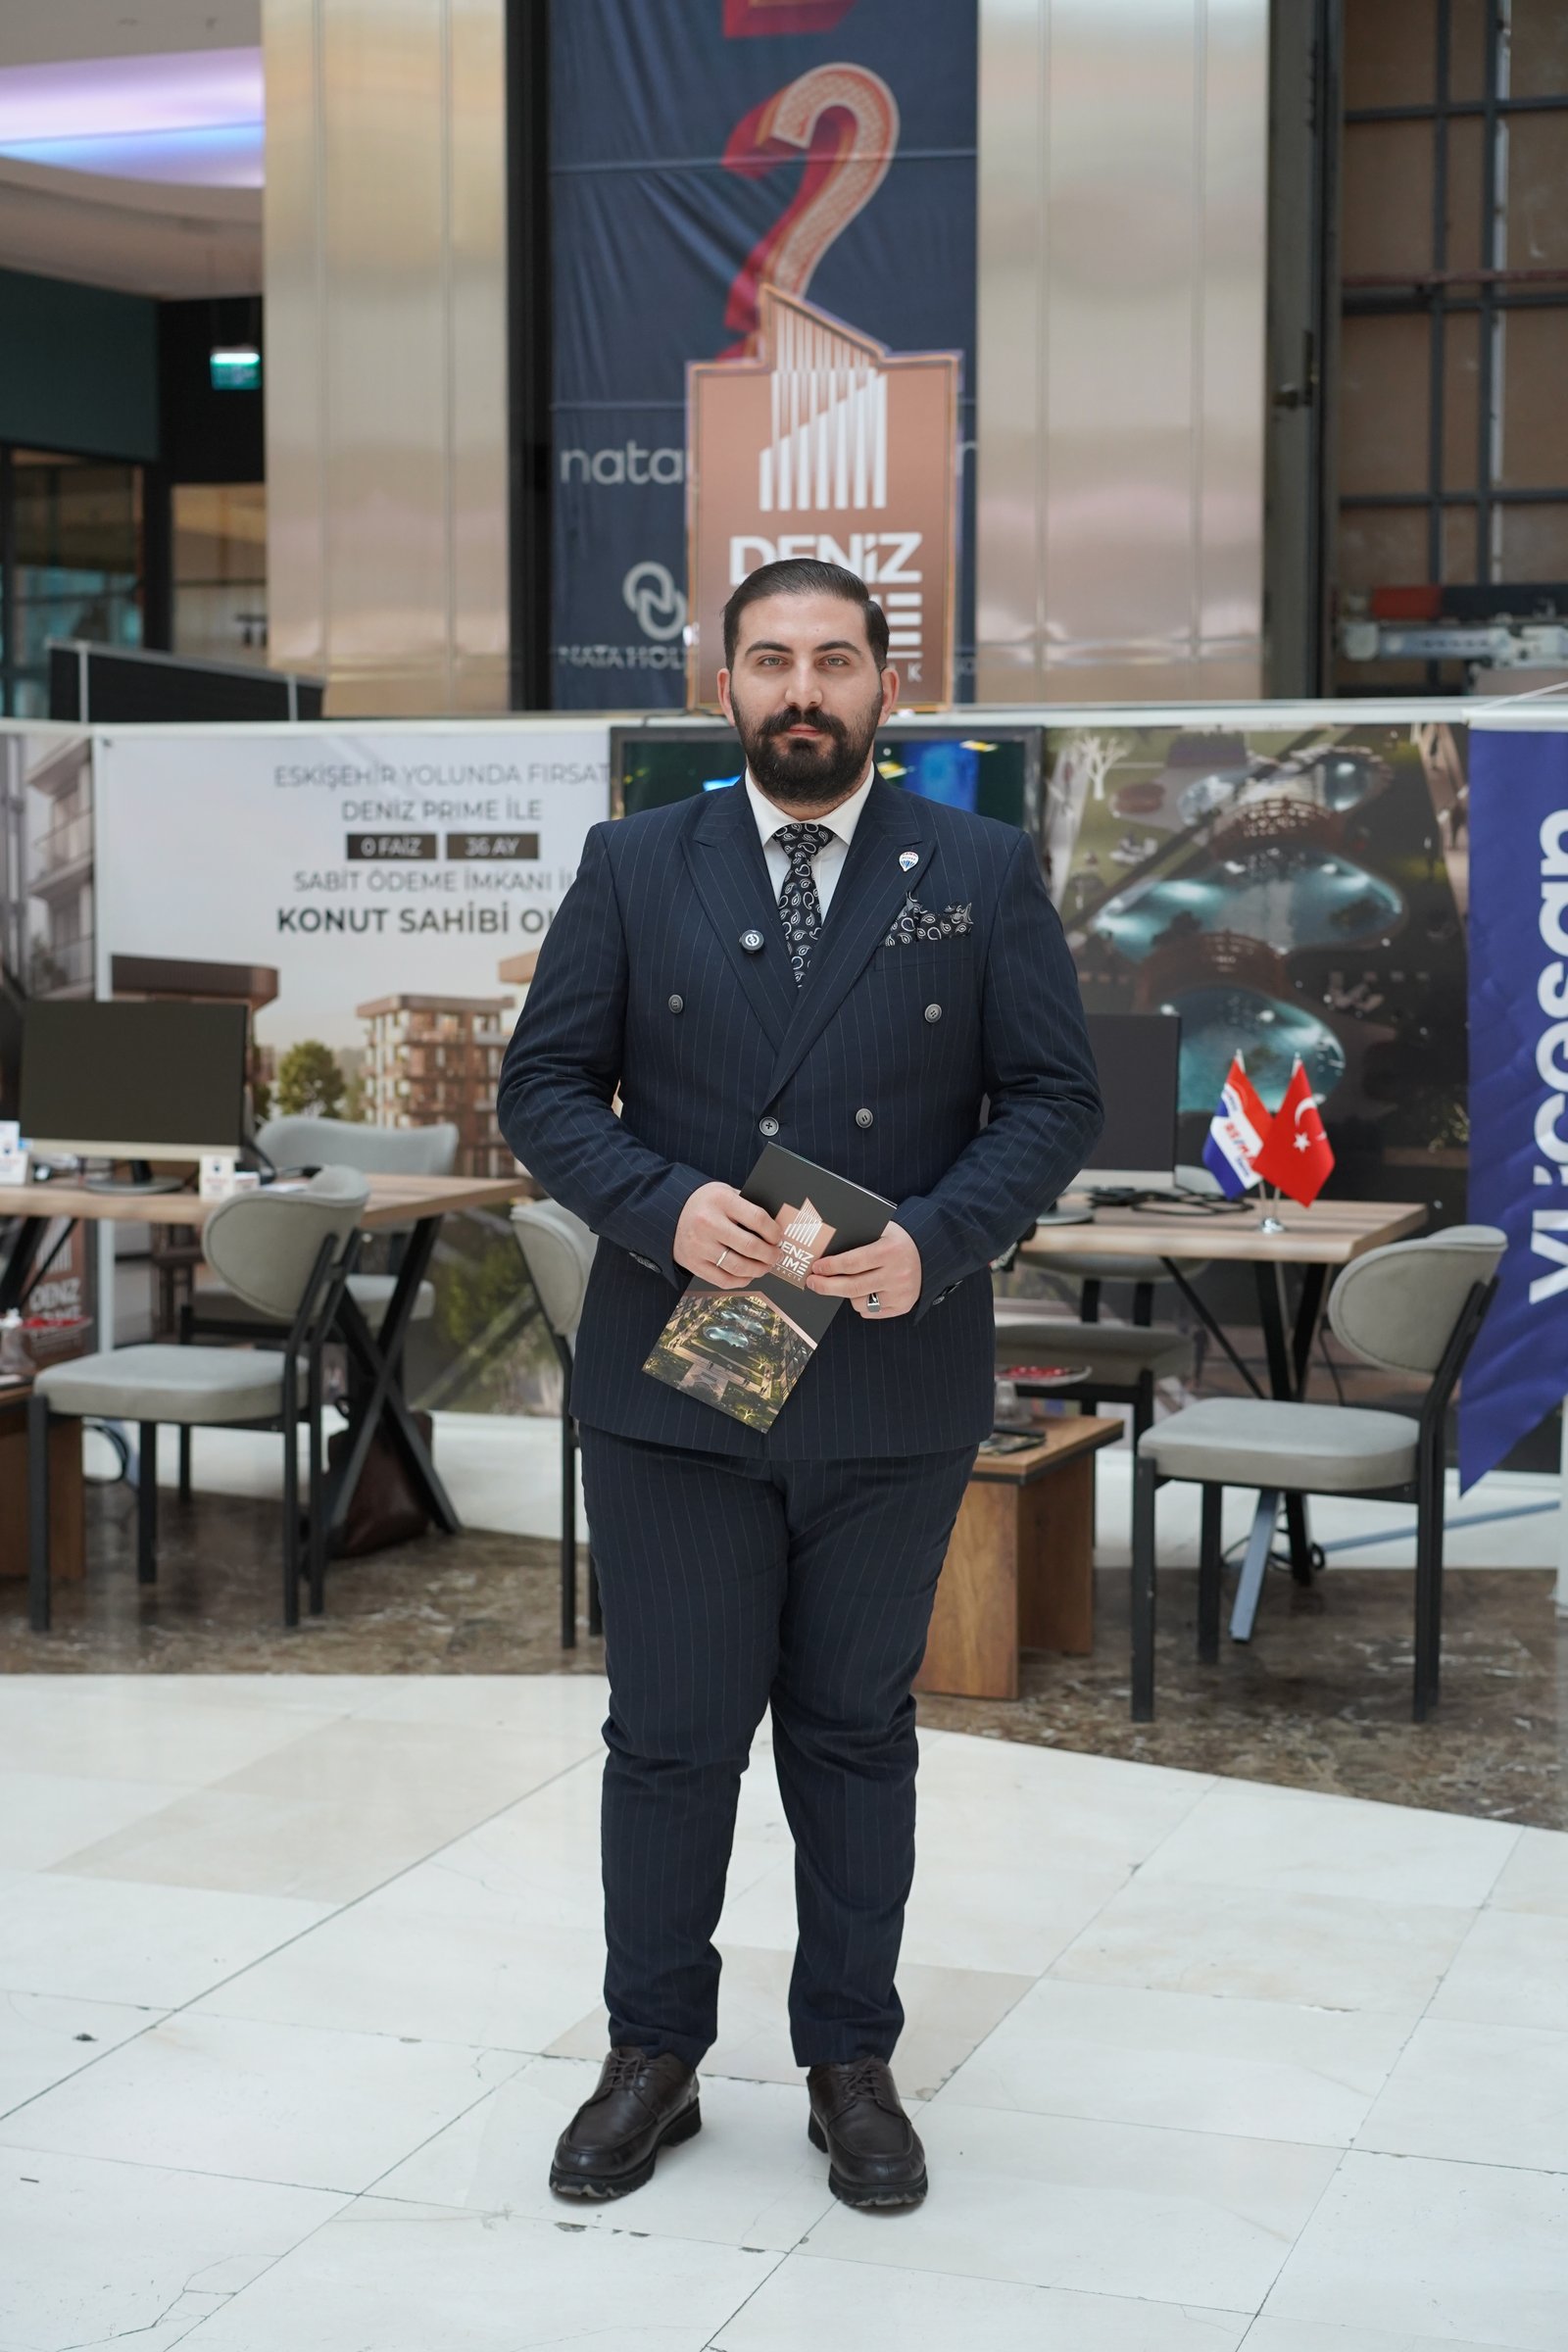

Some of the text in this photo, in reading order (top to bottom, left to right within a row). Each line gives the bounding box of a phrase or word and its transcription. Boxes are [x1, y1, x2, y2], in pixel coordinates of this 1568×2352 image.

[402, 762, 522, 787] YOLUNDA
[342, 794, 543, 822] DENİZ PRIME İLE
[465, 836, 490, 858] 36
[492, 836, 521, 858] AY
[294, 866, 361, 894] SABİT
[366, 866, 458, 893] ÖDEME
[463, 866, 553, 893] İMKANI
[276, 906, 388, 933] KONUT
[399, 900, 509, 935] SAHİBİ
[781, 1254, 809, 1276] IME
